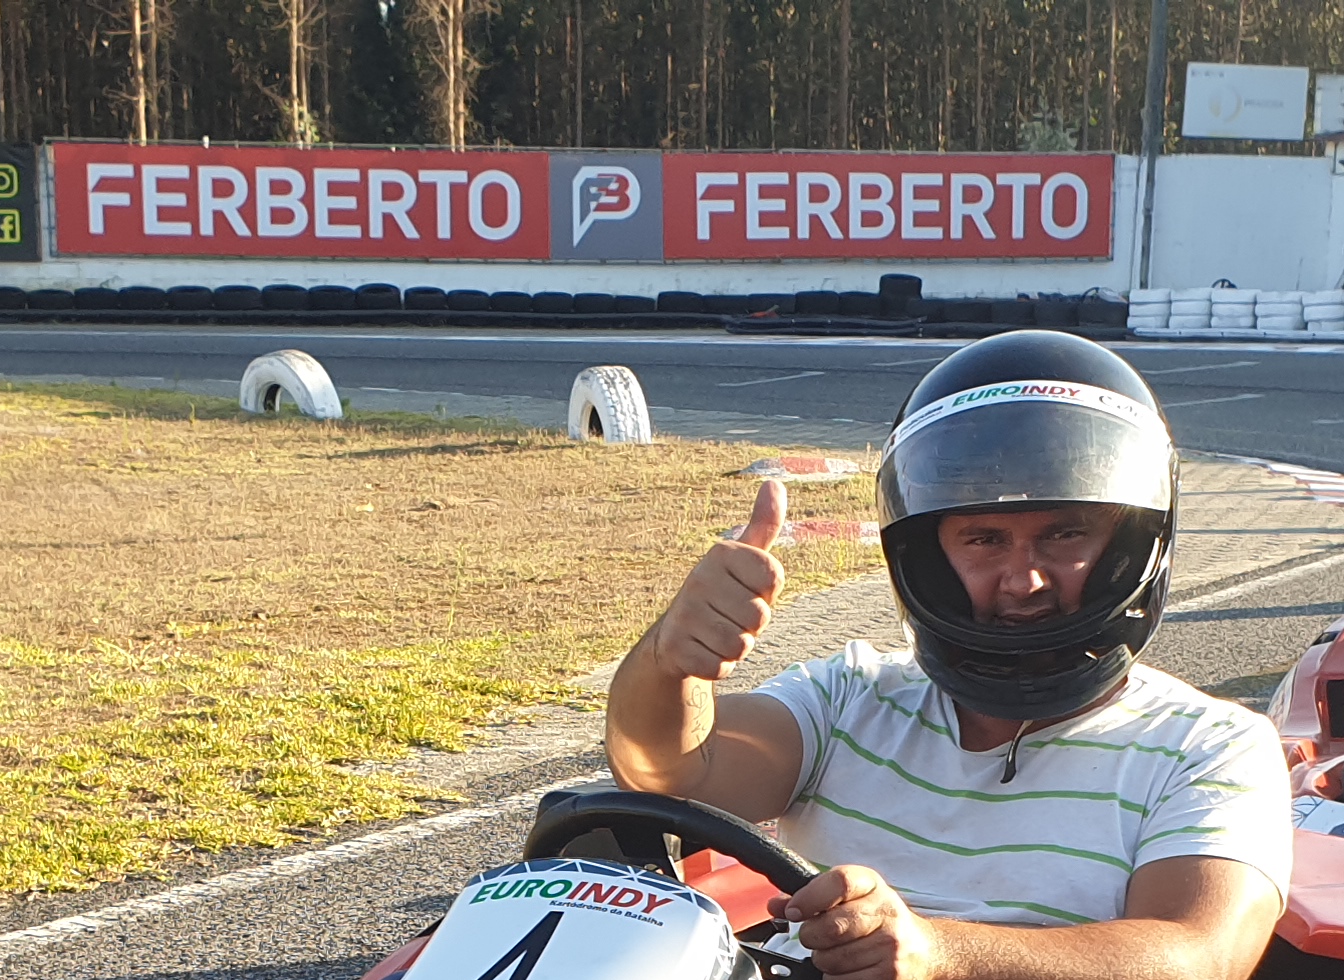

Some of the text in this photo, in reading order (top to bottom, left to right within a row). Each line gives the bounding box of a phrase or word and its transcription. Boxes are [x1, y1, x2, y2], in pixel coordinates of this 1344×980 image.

[86, 163, 522, 243] FERBERTO
[696, 171, 1089, 241] FERBERTO
[951, 385, 1081, 408] EUROINDY
[469, 878, 675, 915] EUROINDY
[550, 899, 664, 928] Kartódromo da Batalha
